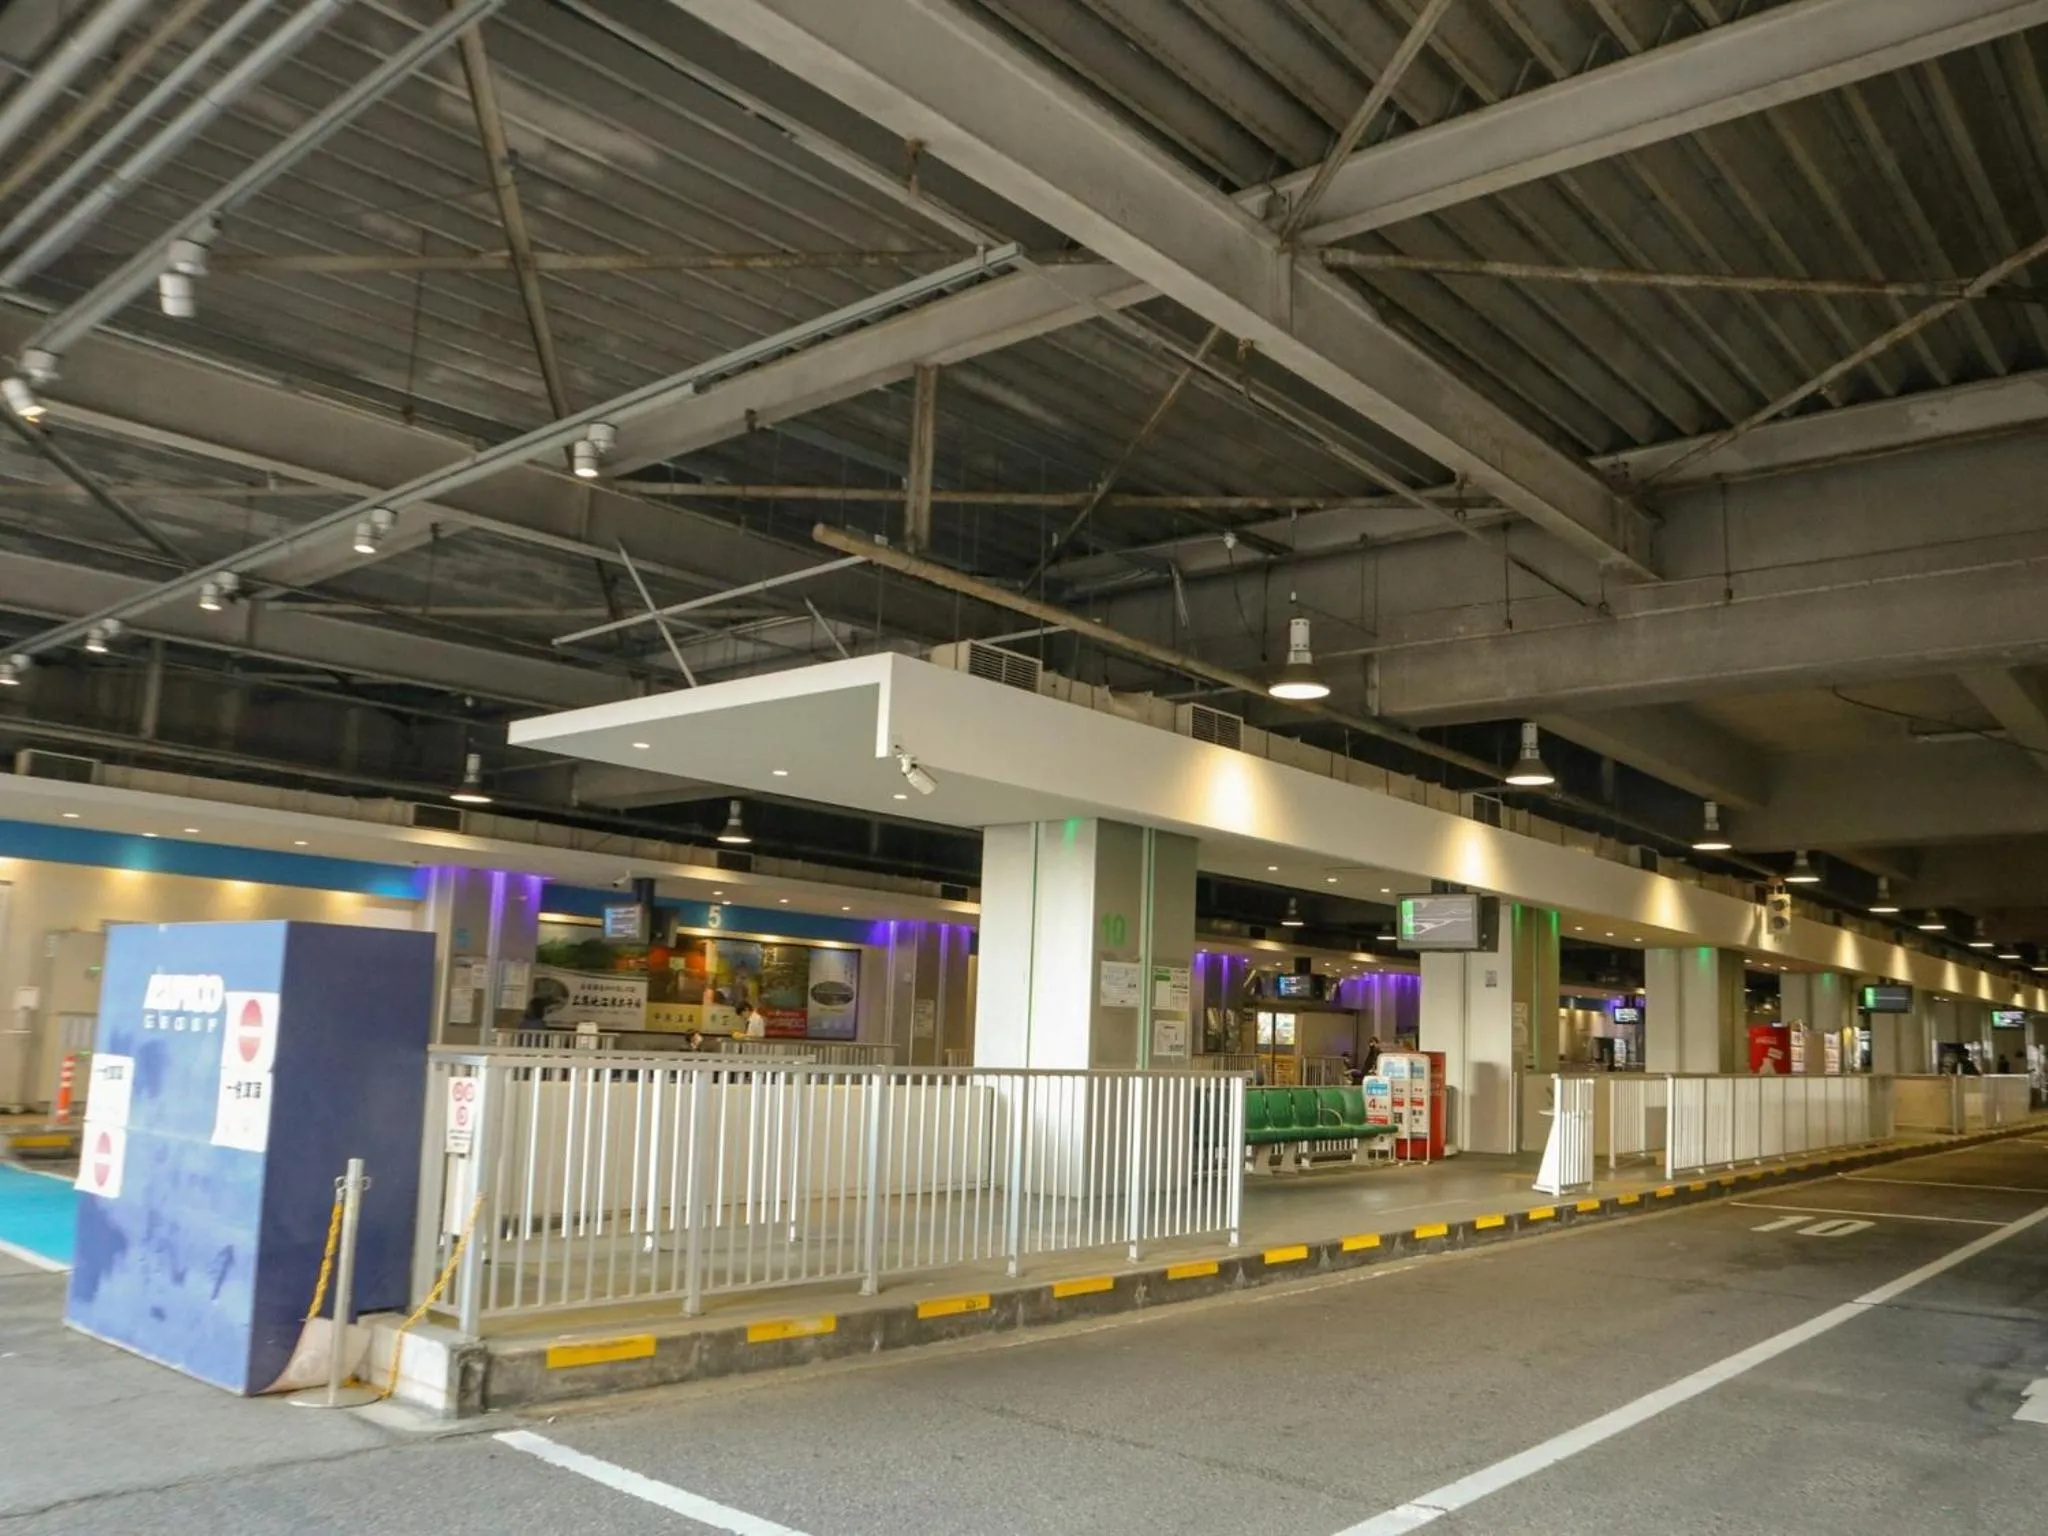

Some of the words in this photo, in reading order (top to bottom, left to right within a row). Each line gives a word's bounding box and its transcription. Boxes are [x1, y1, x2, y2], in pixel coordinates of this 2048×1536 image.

[708, 904, 722, 929] 5
[1102, 914, 1125, 946] 10
[1750, 1215, 1877, 1237] 10
